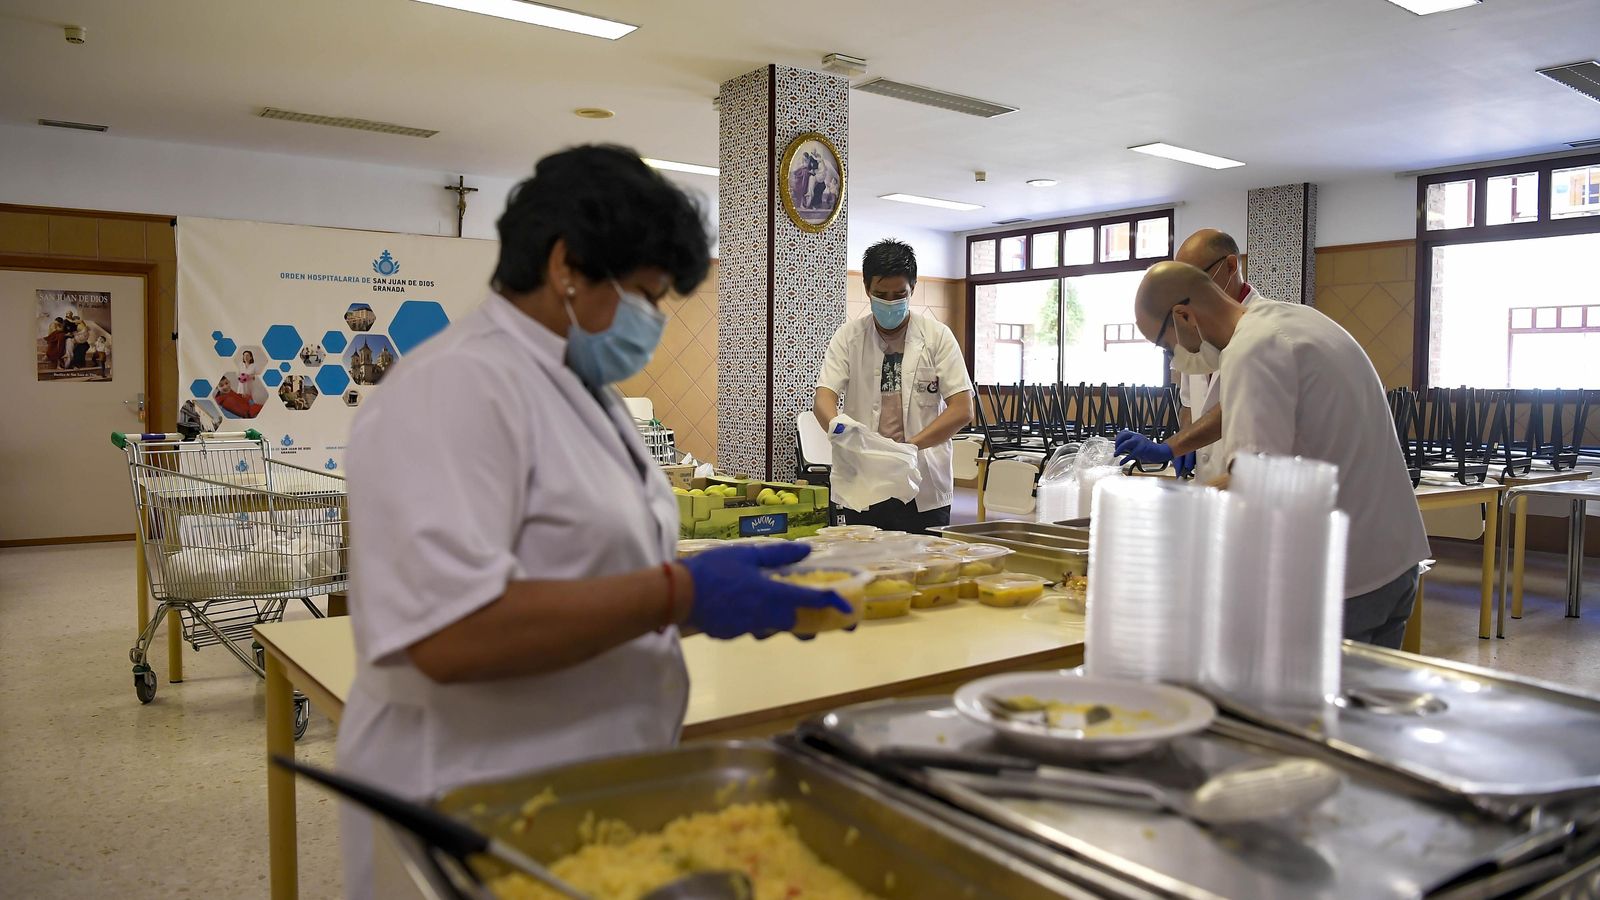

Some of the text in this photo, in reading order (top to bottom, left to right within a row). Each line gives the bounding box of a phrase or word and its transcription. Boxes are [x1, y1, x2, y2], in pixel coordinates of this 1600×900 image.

[280, 272, 305, 280] ORDEN
[307, 274, 360, 283] HOSPITALARIA
[372, 277, 387, 285] SAN
[372, 285, 405, 293] GRANADA
[39, 293, 108, 303] SAN JUAN DE DIOS
